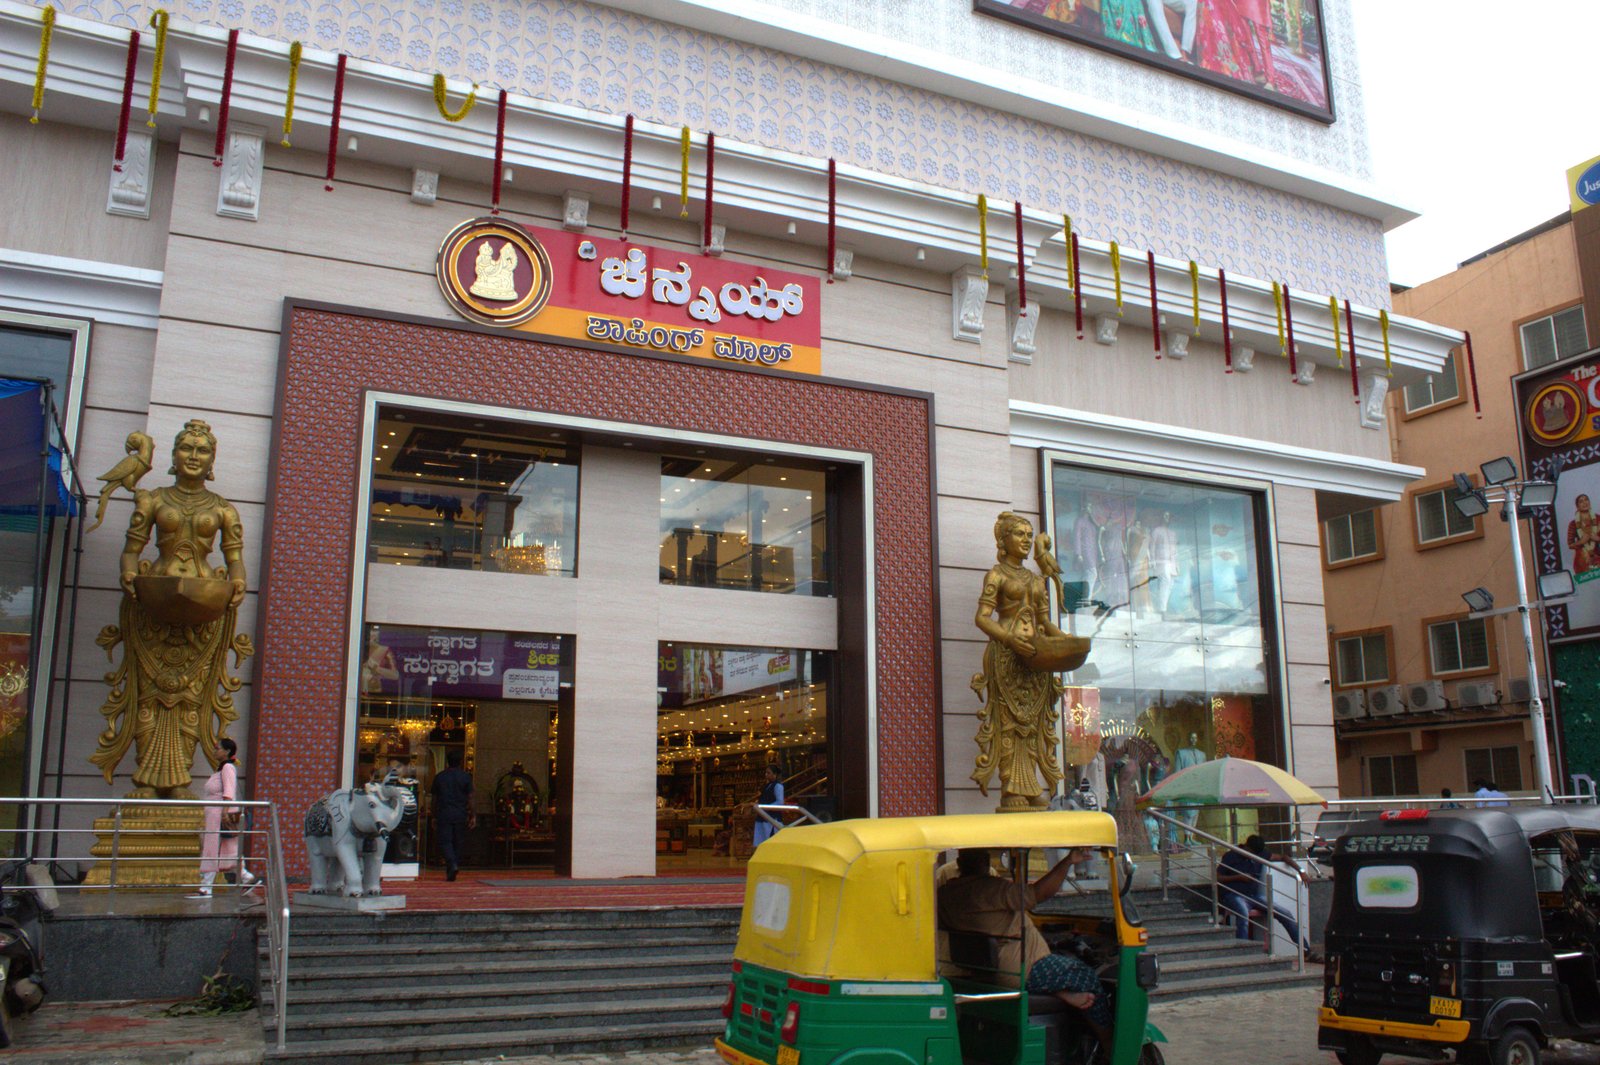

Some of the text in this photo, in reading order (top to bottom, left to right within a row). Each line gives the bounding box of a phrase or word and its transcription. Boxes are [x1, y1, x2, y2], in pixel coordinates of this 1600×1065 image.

[600, 248, 803, 323] ಚೆನ್ನಯ್
[586, 315, 793, 365] ಶಾಪಿಂಗ್ ಮಾಲ್
[1570, 365, 1597, 381] The
[427, 635, 477, 655] ಸ್ವಾಗತ
[403, 654, 495, 685] ಸುಸ್ವಾಗತ
[527, 649, 560, 669] ಶ್ರೀಕ
